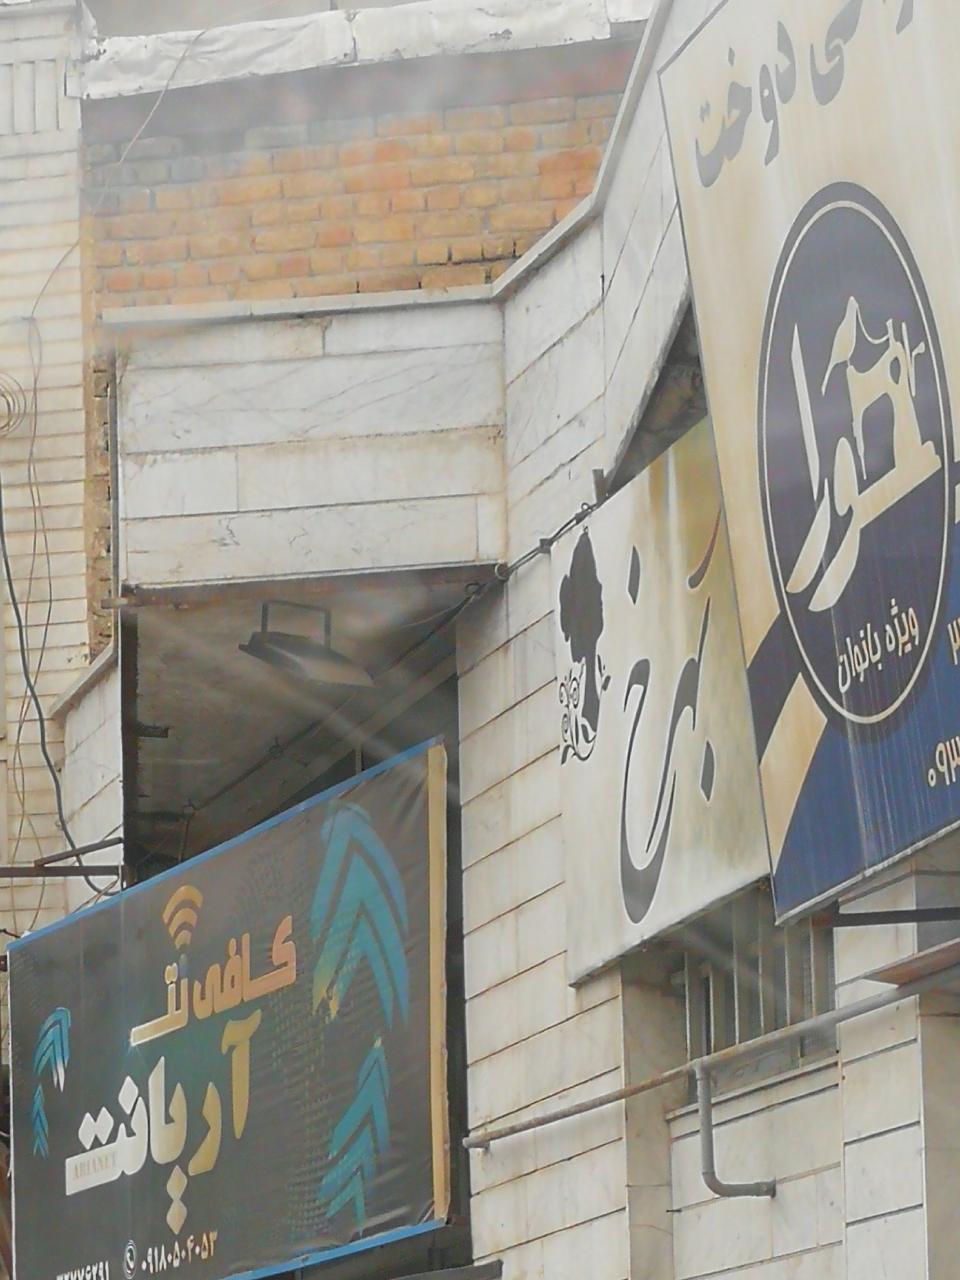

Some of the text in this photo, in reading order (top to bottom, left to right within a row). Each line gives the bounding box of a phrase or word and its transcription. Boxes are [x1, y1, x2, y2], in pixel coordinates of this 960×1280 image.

[838, 598, 920, 694] ویژه بانوان
[130, 914, 297, 1047] کافی نت
